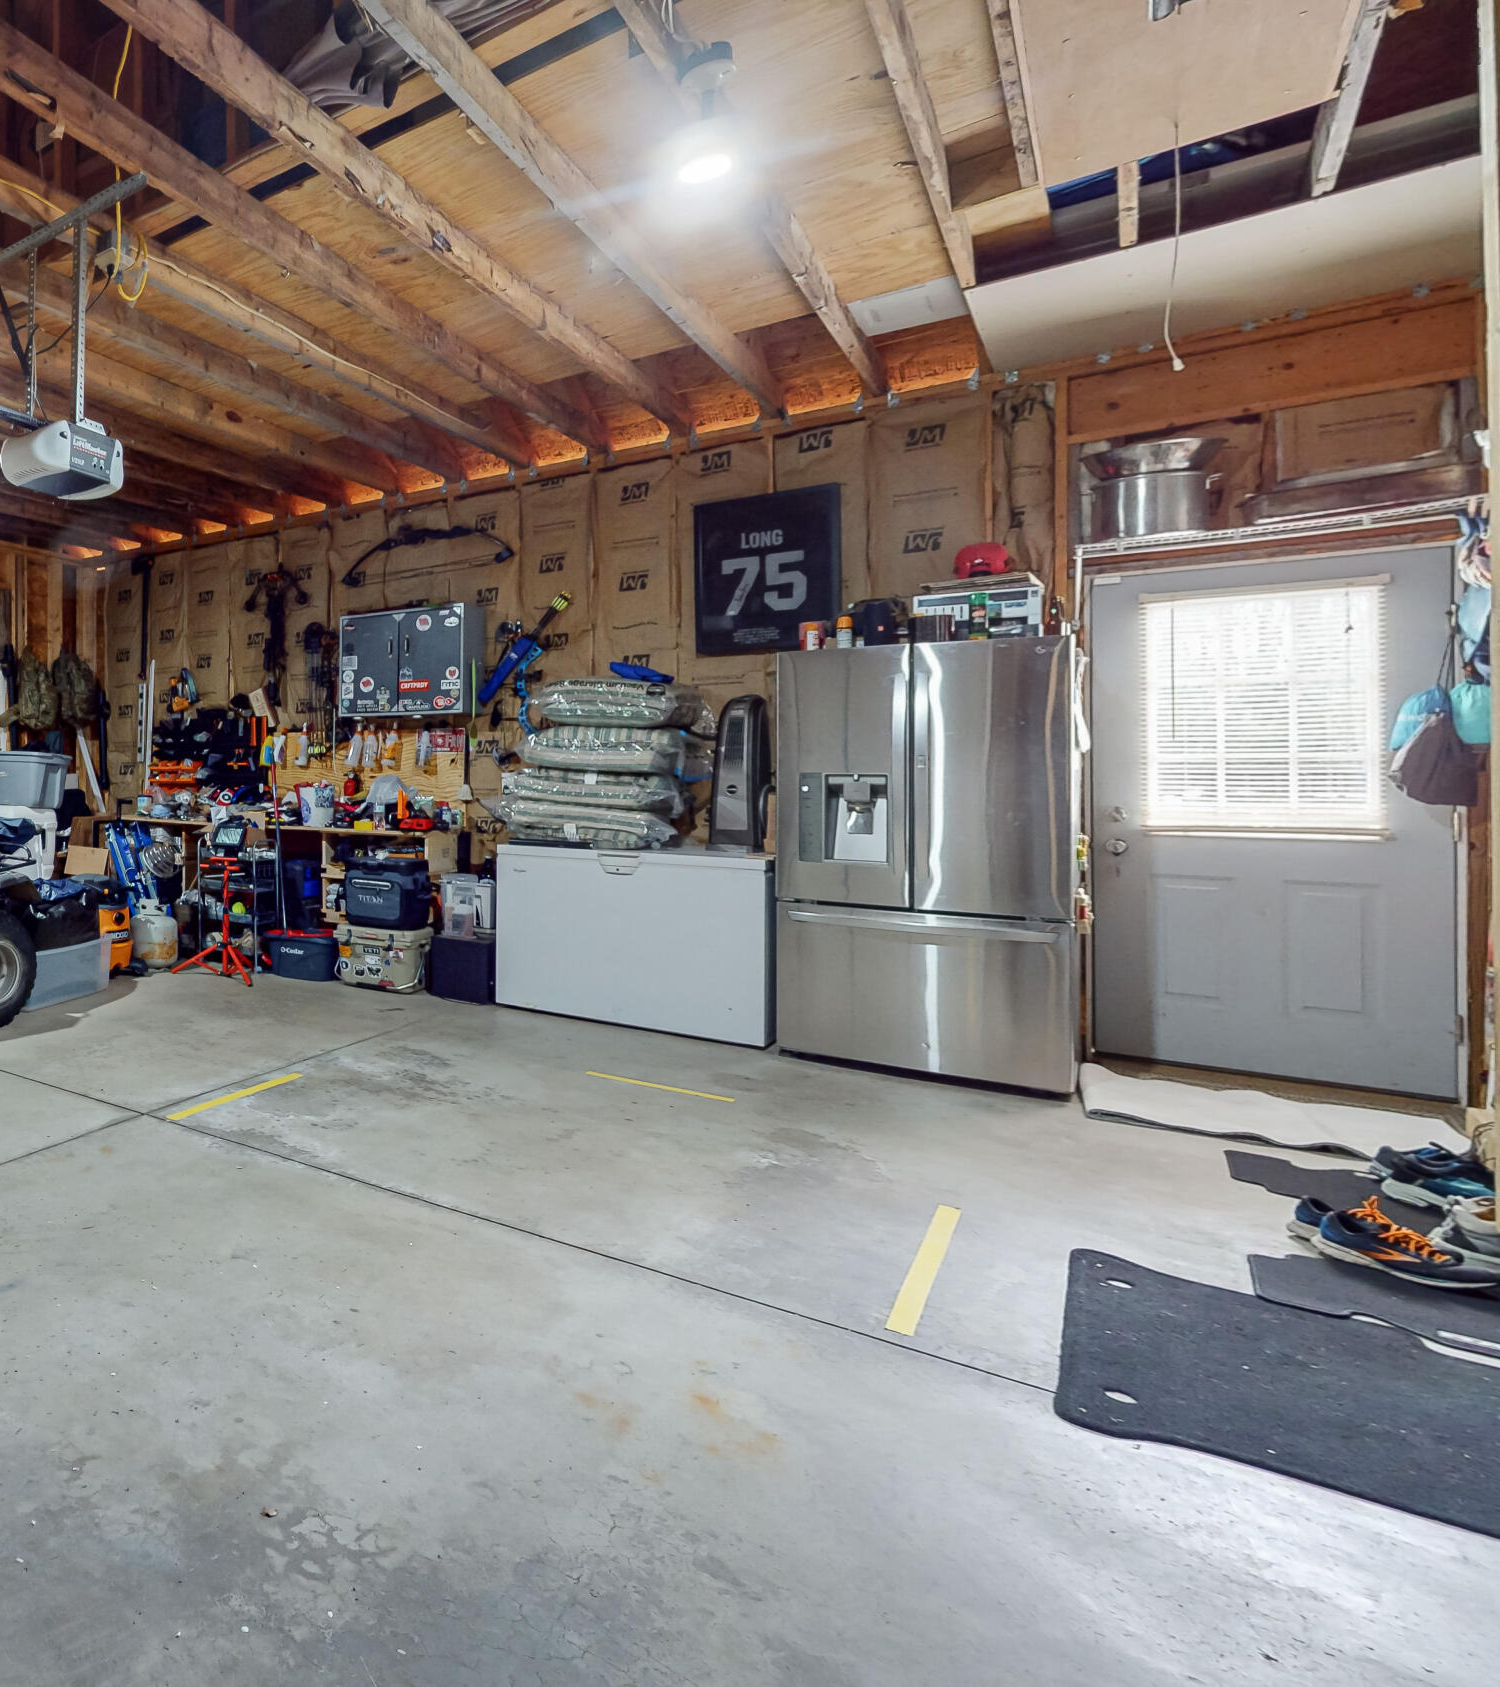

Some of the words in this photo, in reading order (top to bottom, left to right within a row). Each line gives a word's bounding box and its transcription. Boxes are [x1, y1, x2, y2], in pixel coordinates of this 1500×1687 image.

[799, 430, 833, 453] JM
[906, 424, 946, 447] JM
[702, 451, 731, 471] JM
[621, 482, 649, 501] JM
[741, 529, 783, 549] LONG
[903, 532, 943, 553] JM
[619, 573, 649, 591] JM
[722, 550, 807, 616] 75
[358, 895, 384, 904] TITAN
[280, 947, 304, 955] O-Cedar
